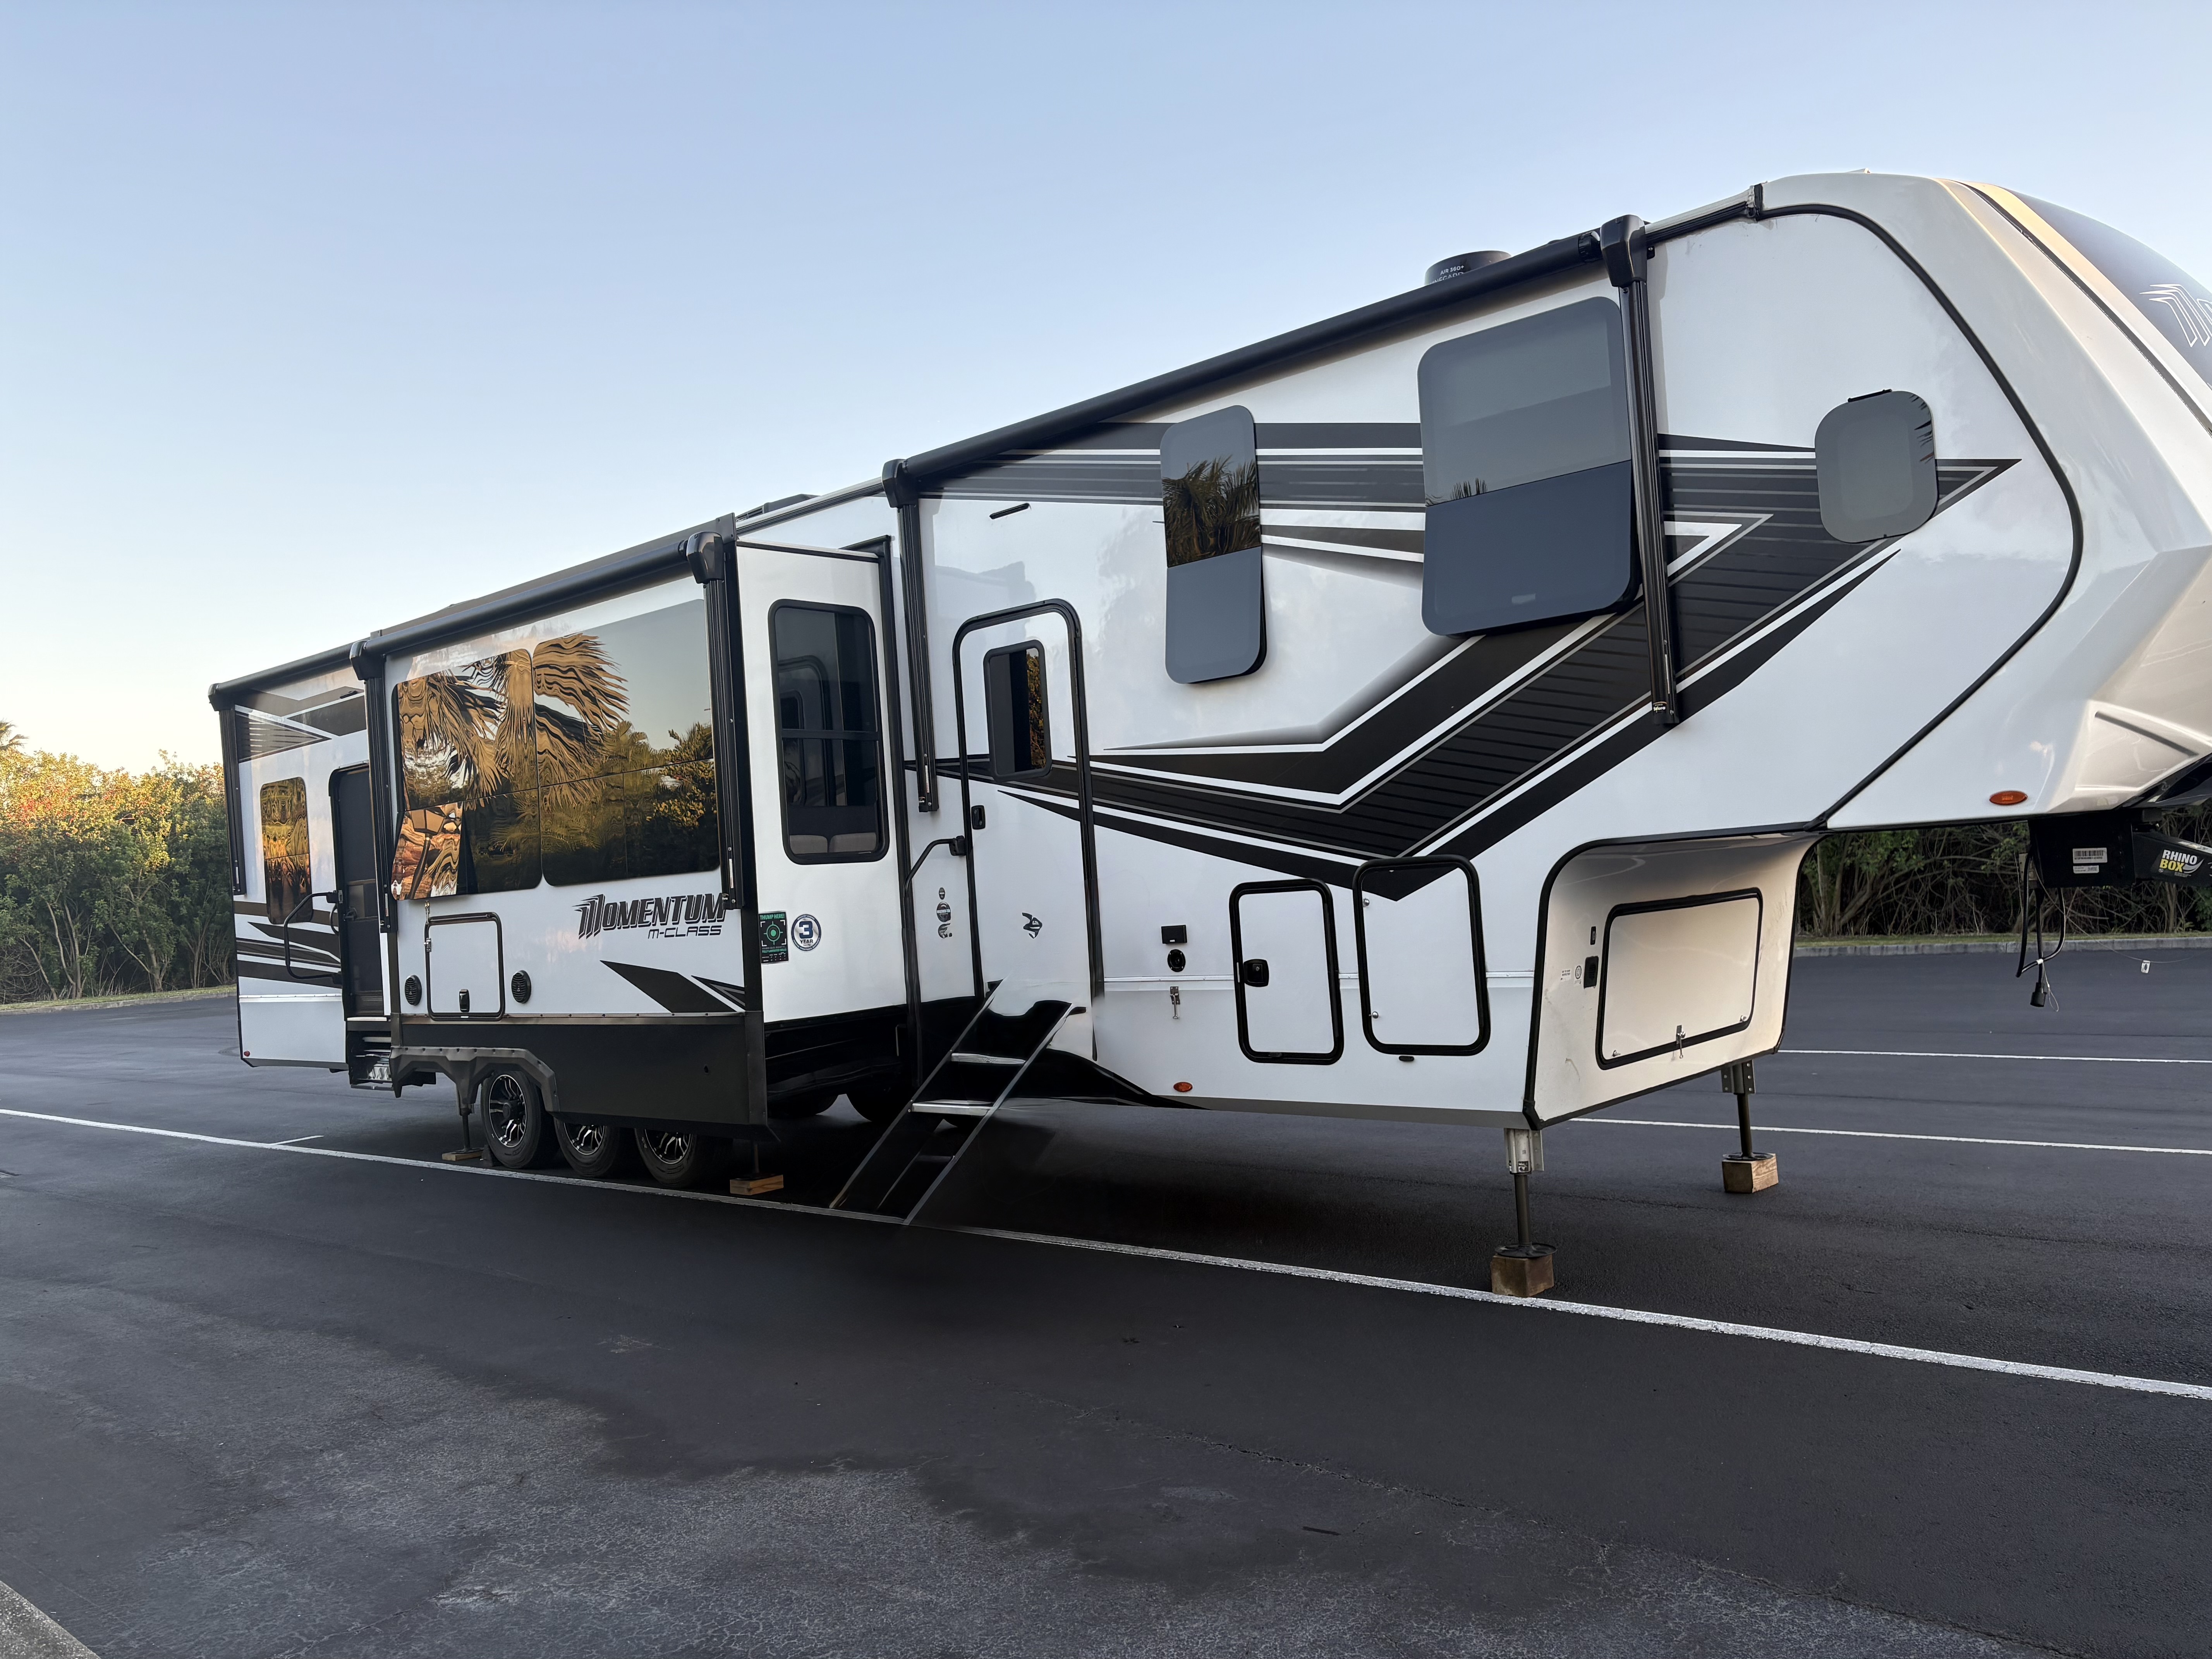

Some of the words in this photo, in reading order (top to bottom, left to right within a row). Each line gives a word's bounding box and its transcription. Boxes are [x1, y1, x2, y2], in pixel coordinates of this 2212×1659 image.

[2159, 859, 2185, 872] BOX
[2162, 849, 2198, 865] RHINO
[572, 893, 726, 940] MOMENTUM
[799, 921, 814, 939] 3
